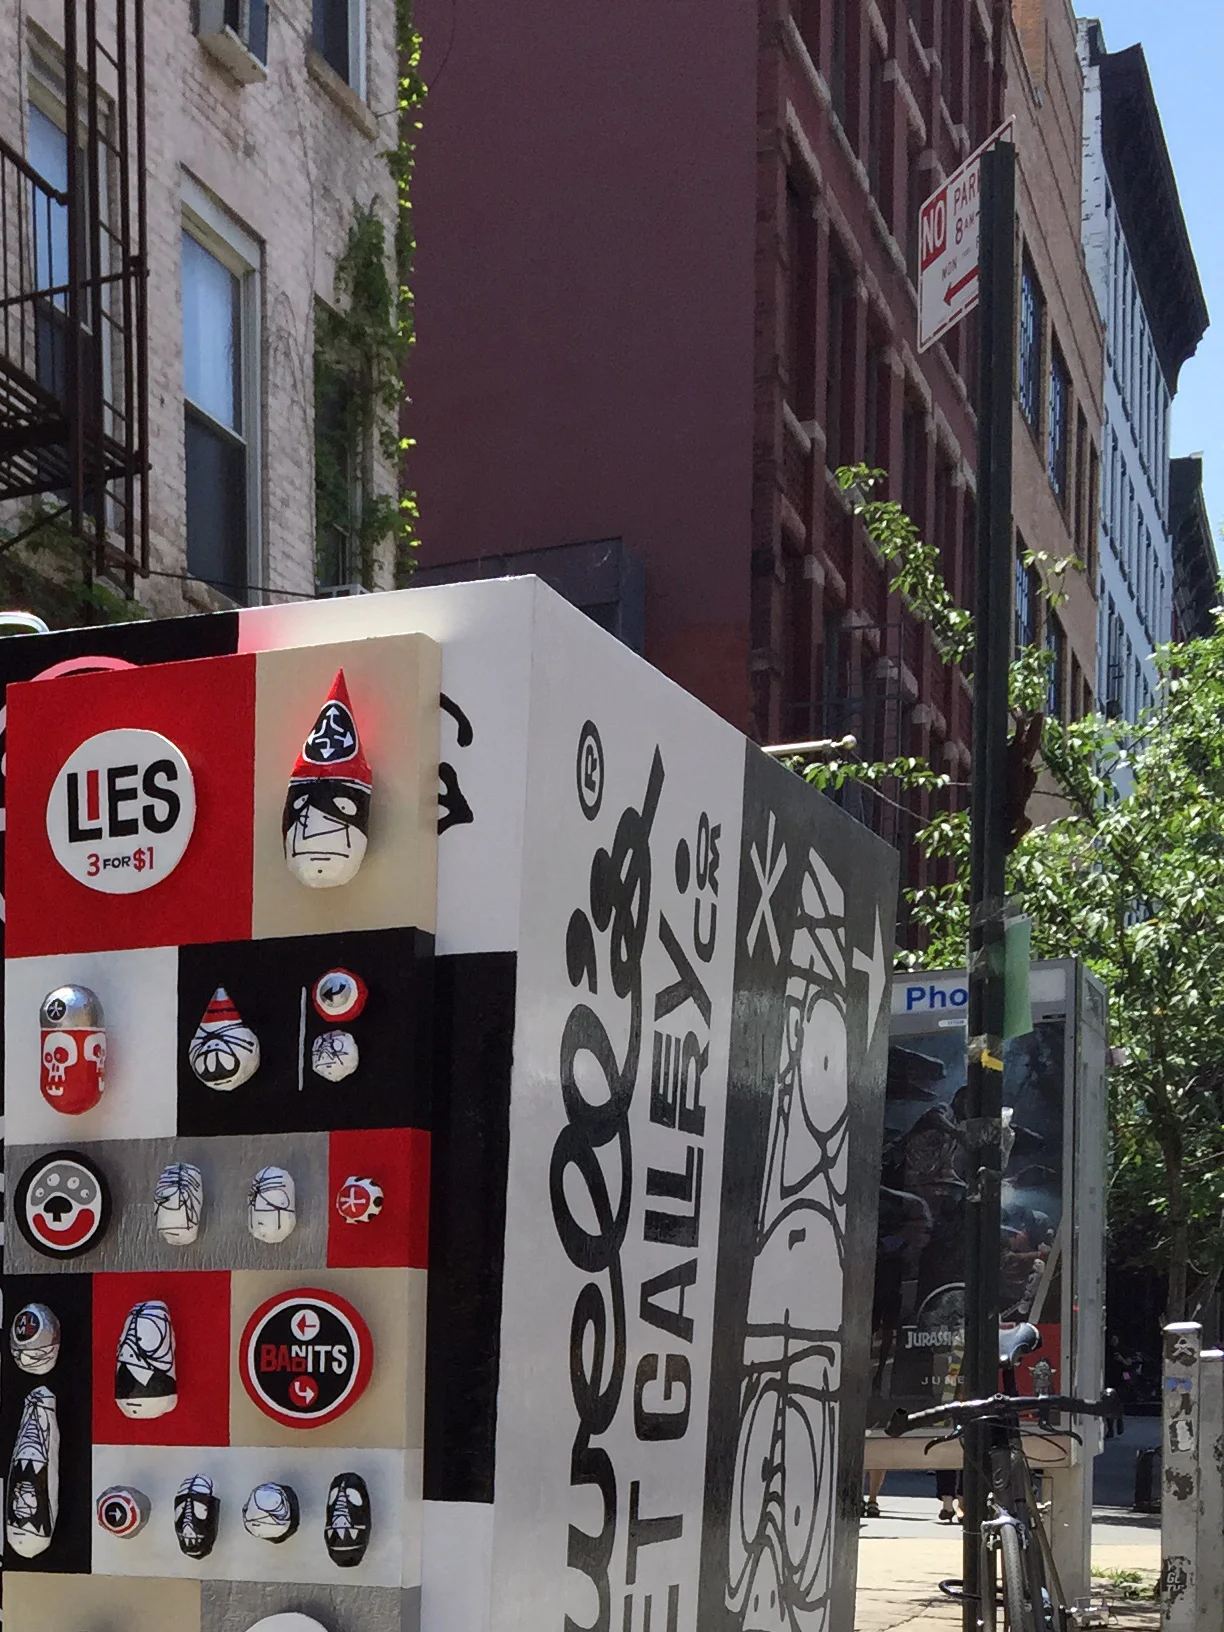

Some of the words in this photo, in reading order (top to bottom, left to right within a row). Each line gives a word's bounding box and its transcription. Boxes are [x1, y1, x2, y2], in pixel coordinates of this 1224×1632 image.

[922, 200, 945, 261] NO
[67, 759, 181, 843] LIES
[86, 853, 100, 877] 3
[103, 856, 131, 870] FOR
[133, 846, 154, 872] $1
[906, 985, 968, 1010] Pho
[921, 1375, 965, 1386] JUNE
